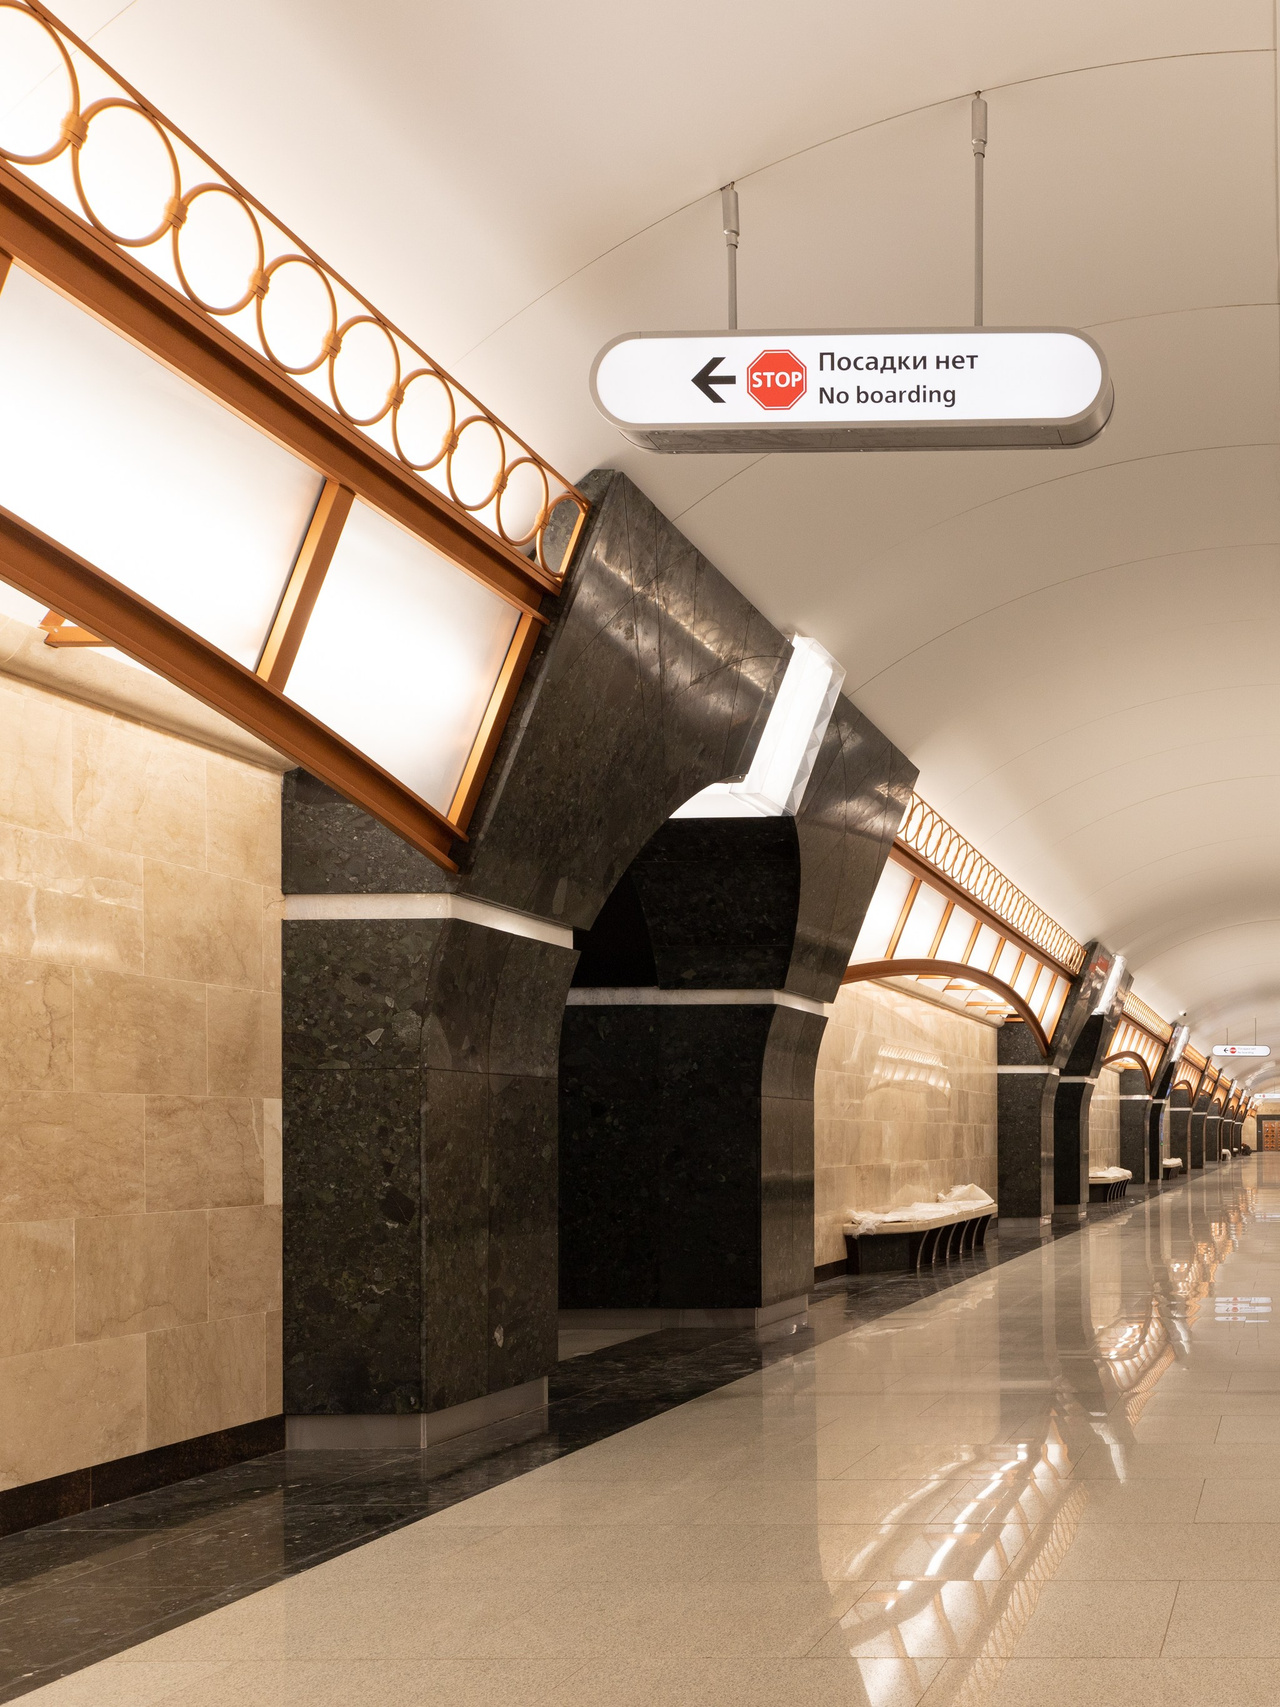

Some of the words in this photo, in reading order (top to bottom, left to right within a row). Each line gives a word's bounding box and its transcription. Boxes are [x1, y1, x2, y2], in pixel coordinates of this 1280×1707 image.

[818, 351, 928, 374] Посадки
[935, 354, 979, 370] нет
[752, 371, 803, 388] STOP
[818, 387, 850, 405] No
[856, 384, 957, 408] boarding
